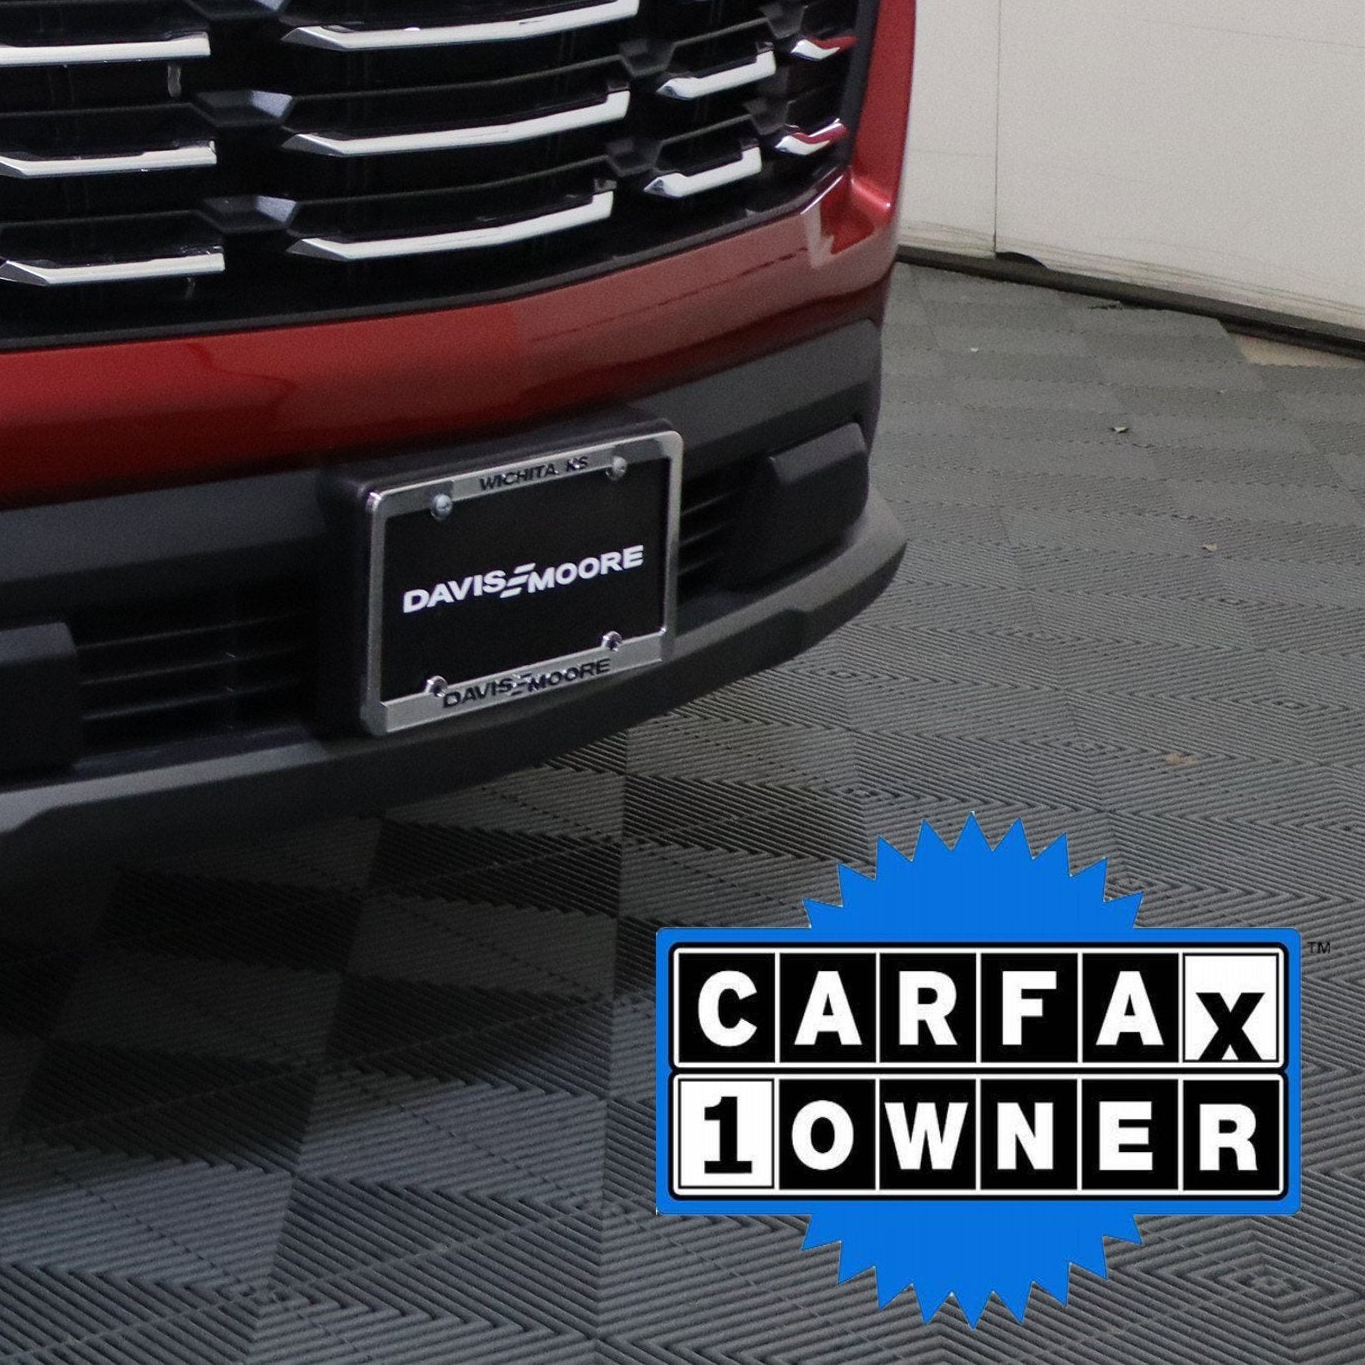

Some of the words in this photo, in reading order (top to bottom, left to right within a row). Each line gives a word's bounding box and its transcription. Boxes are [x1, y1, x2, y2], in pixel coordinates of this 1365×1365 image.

[403, 569, 507, 614] DAVIS
[528, 545, 645, 594] MOORE
[443, 677, 513, 708] DAVIS
[528, 658, 612, 693] MOORE
